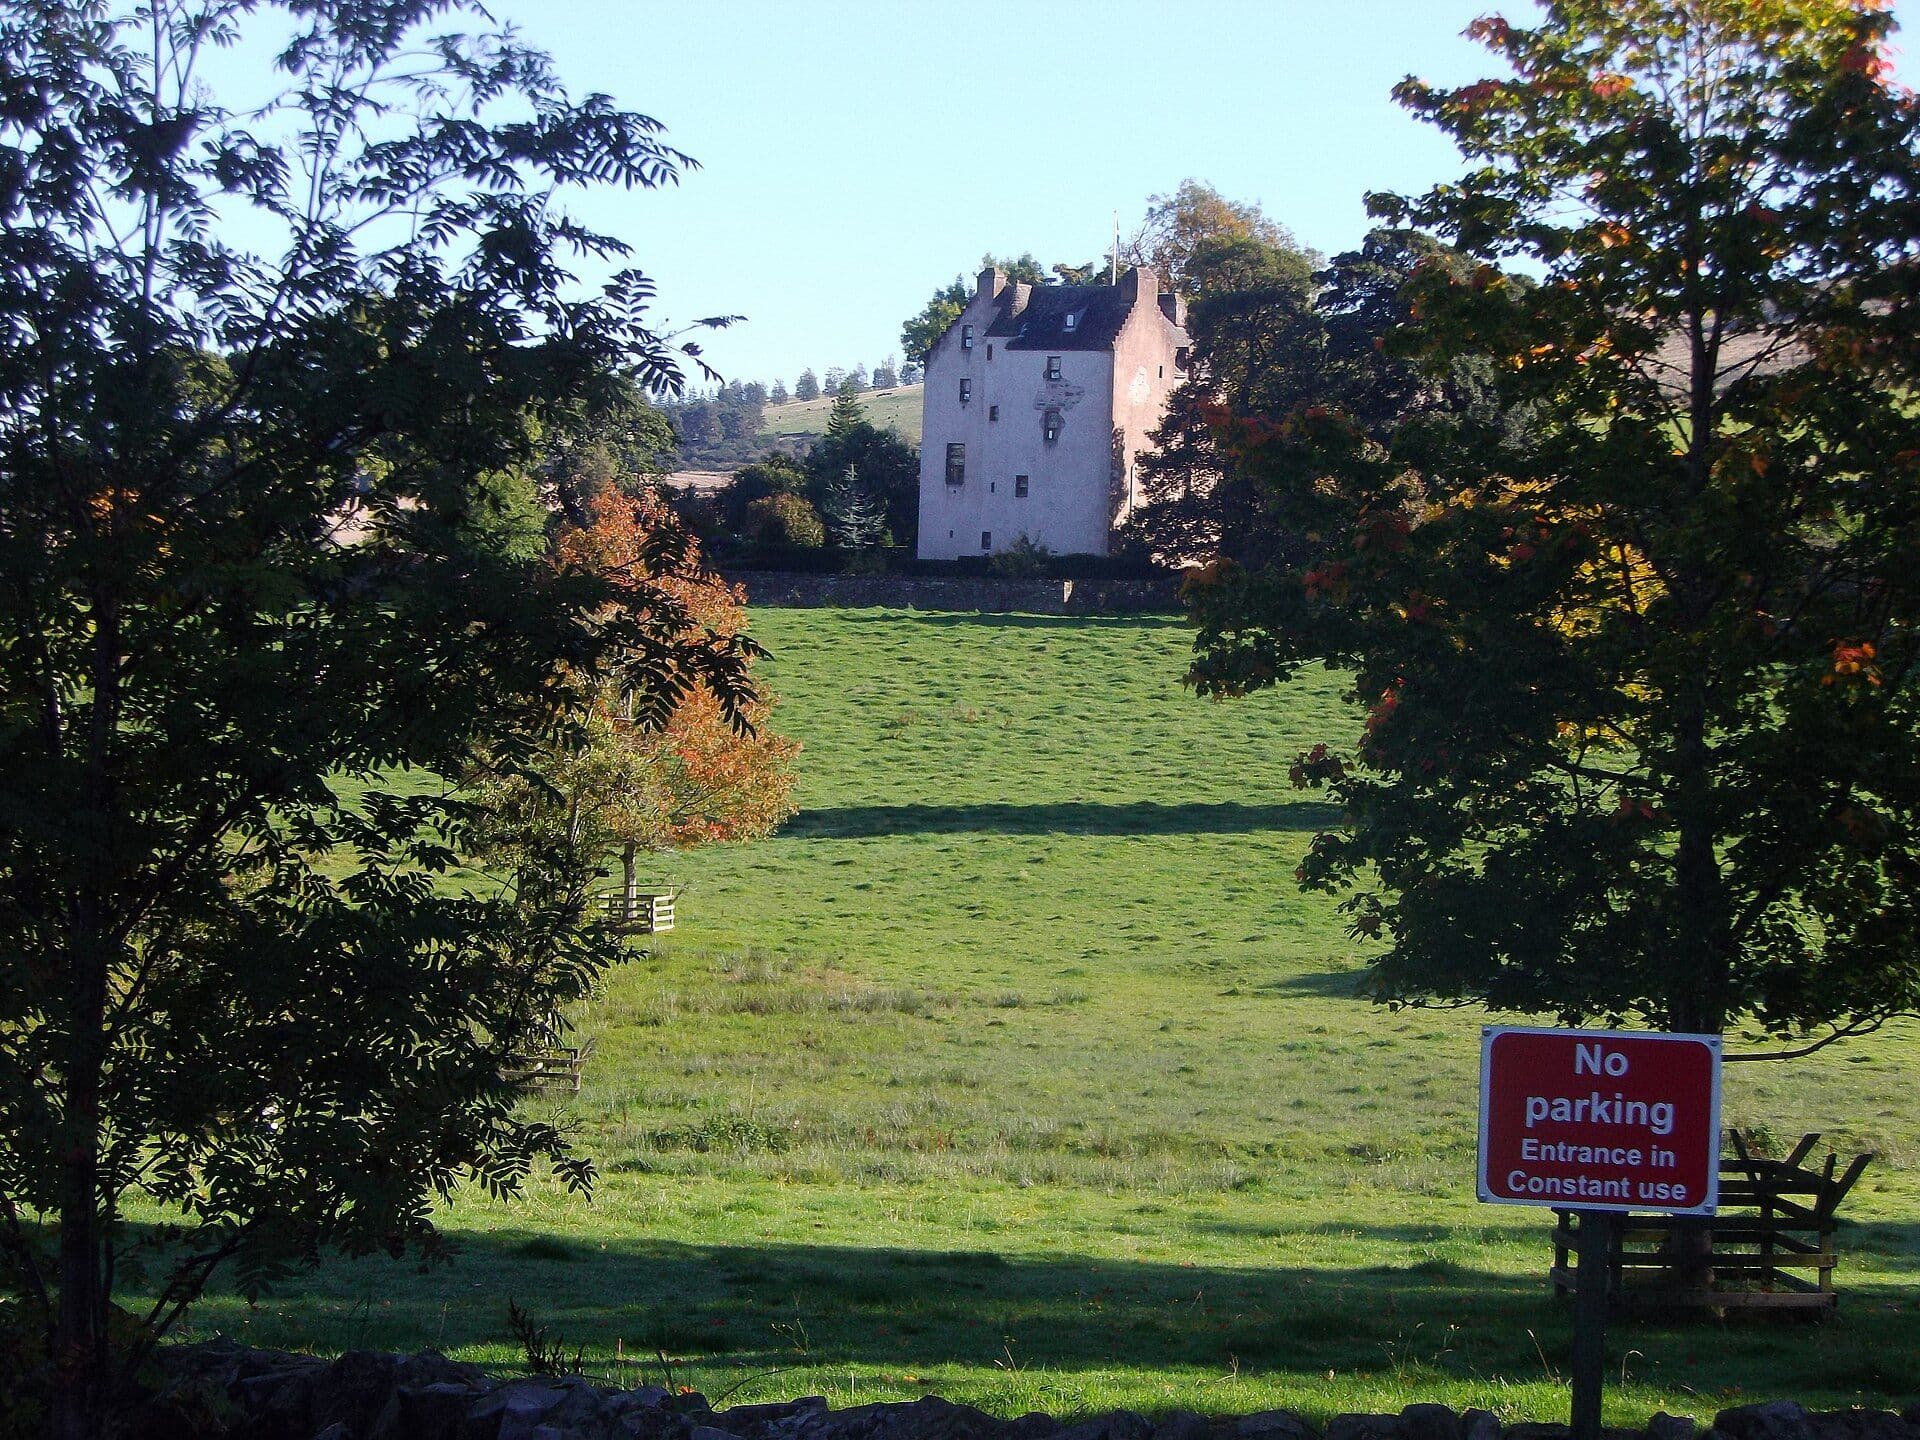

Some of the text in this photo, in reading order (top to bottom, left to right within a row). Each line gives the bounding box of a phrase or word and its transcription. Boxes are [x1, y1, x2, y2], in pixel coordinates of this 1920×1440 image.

[1574, 1043, 1629, 1077] No
[1525, 1092, 1674, 1135] parking
[1521, 1138, 1675, 1168] Entrance in
[1507, 1170, 1687, 1200] Constant use
